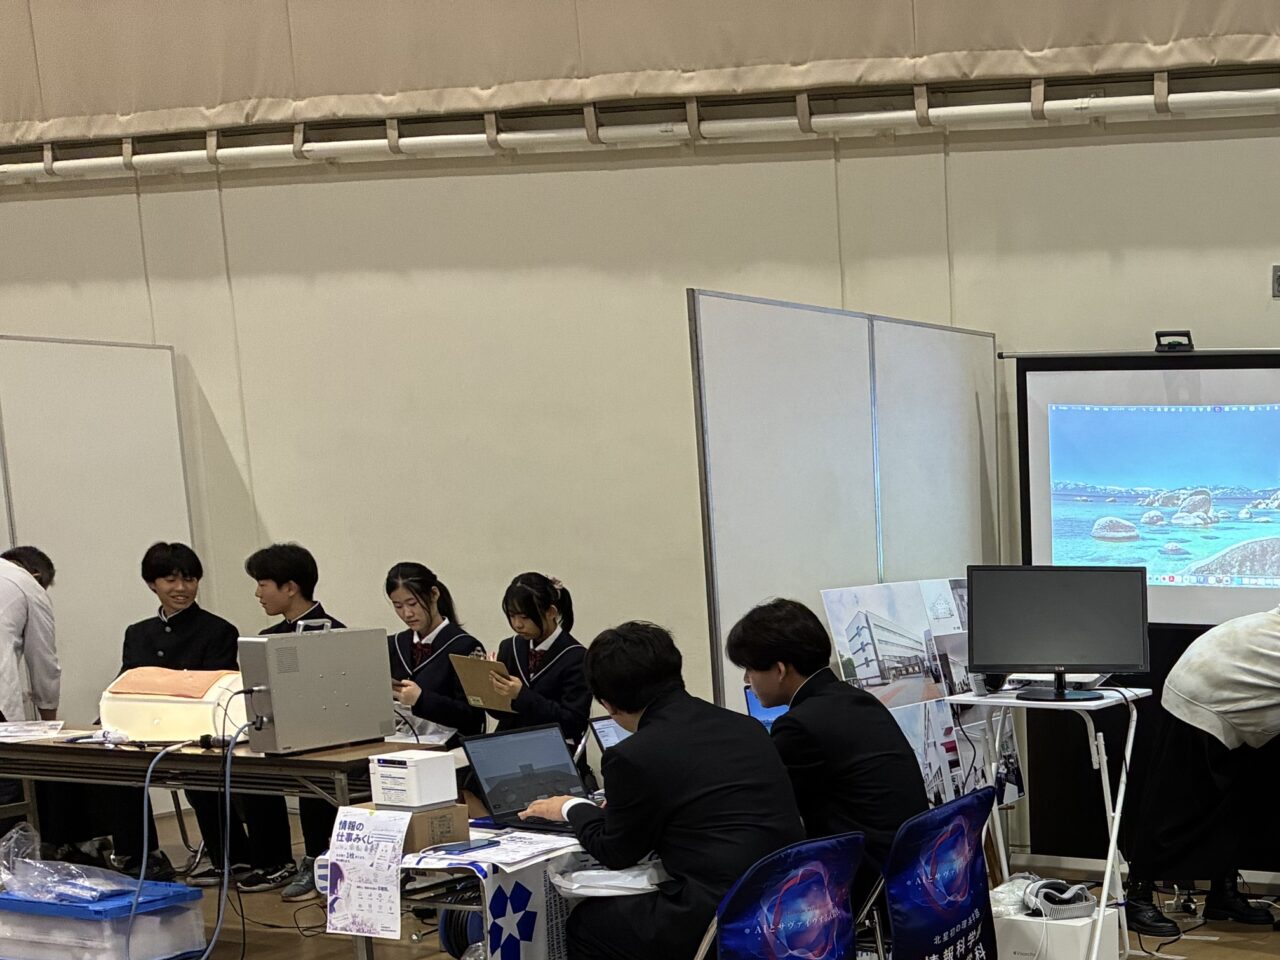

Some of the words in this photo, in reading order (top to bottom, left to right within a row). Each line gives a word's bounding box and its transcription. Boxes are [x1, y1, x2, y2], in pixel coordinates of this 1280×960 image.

[338, 819, 364, 832] 情報の
[336, 832, 374, 845] 仕事みくじ
